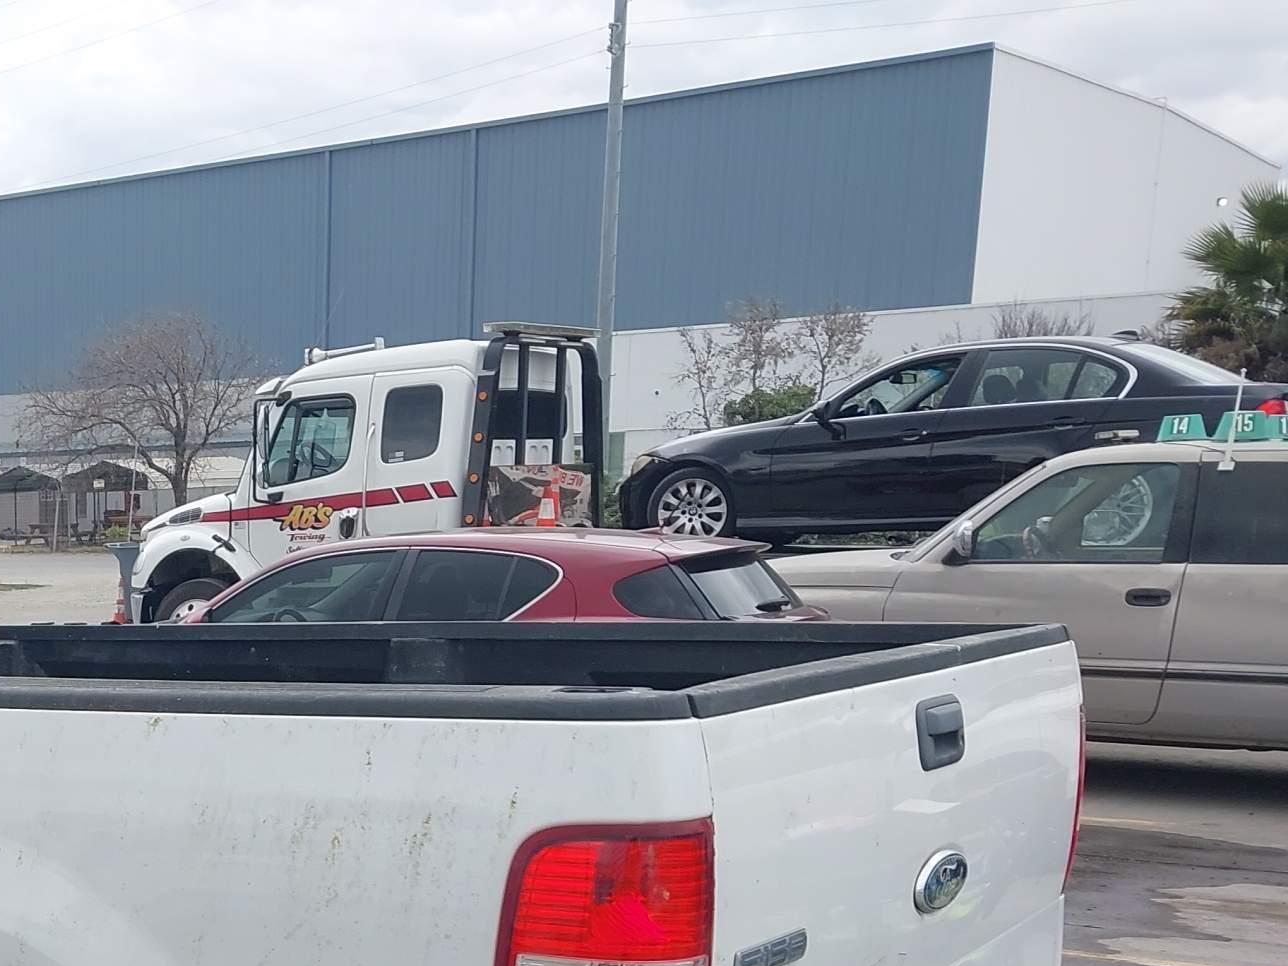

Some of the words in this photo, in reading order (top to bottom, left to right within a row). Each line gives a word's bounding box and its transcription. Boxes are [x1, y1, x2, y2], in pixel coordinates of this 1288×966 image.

[1172, 416, 1189, 434] 14
[1236, 413, 1254, 433] 15
[280, 503, 333, 530] AB'S
[287, 533, 326, 542] Towing
